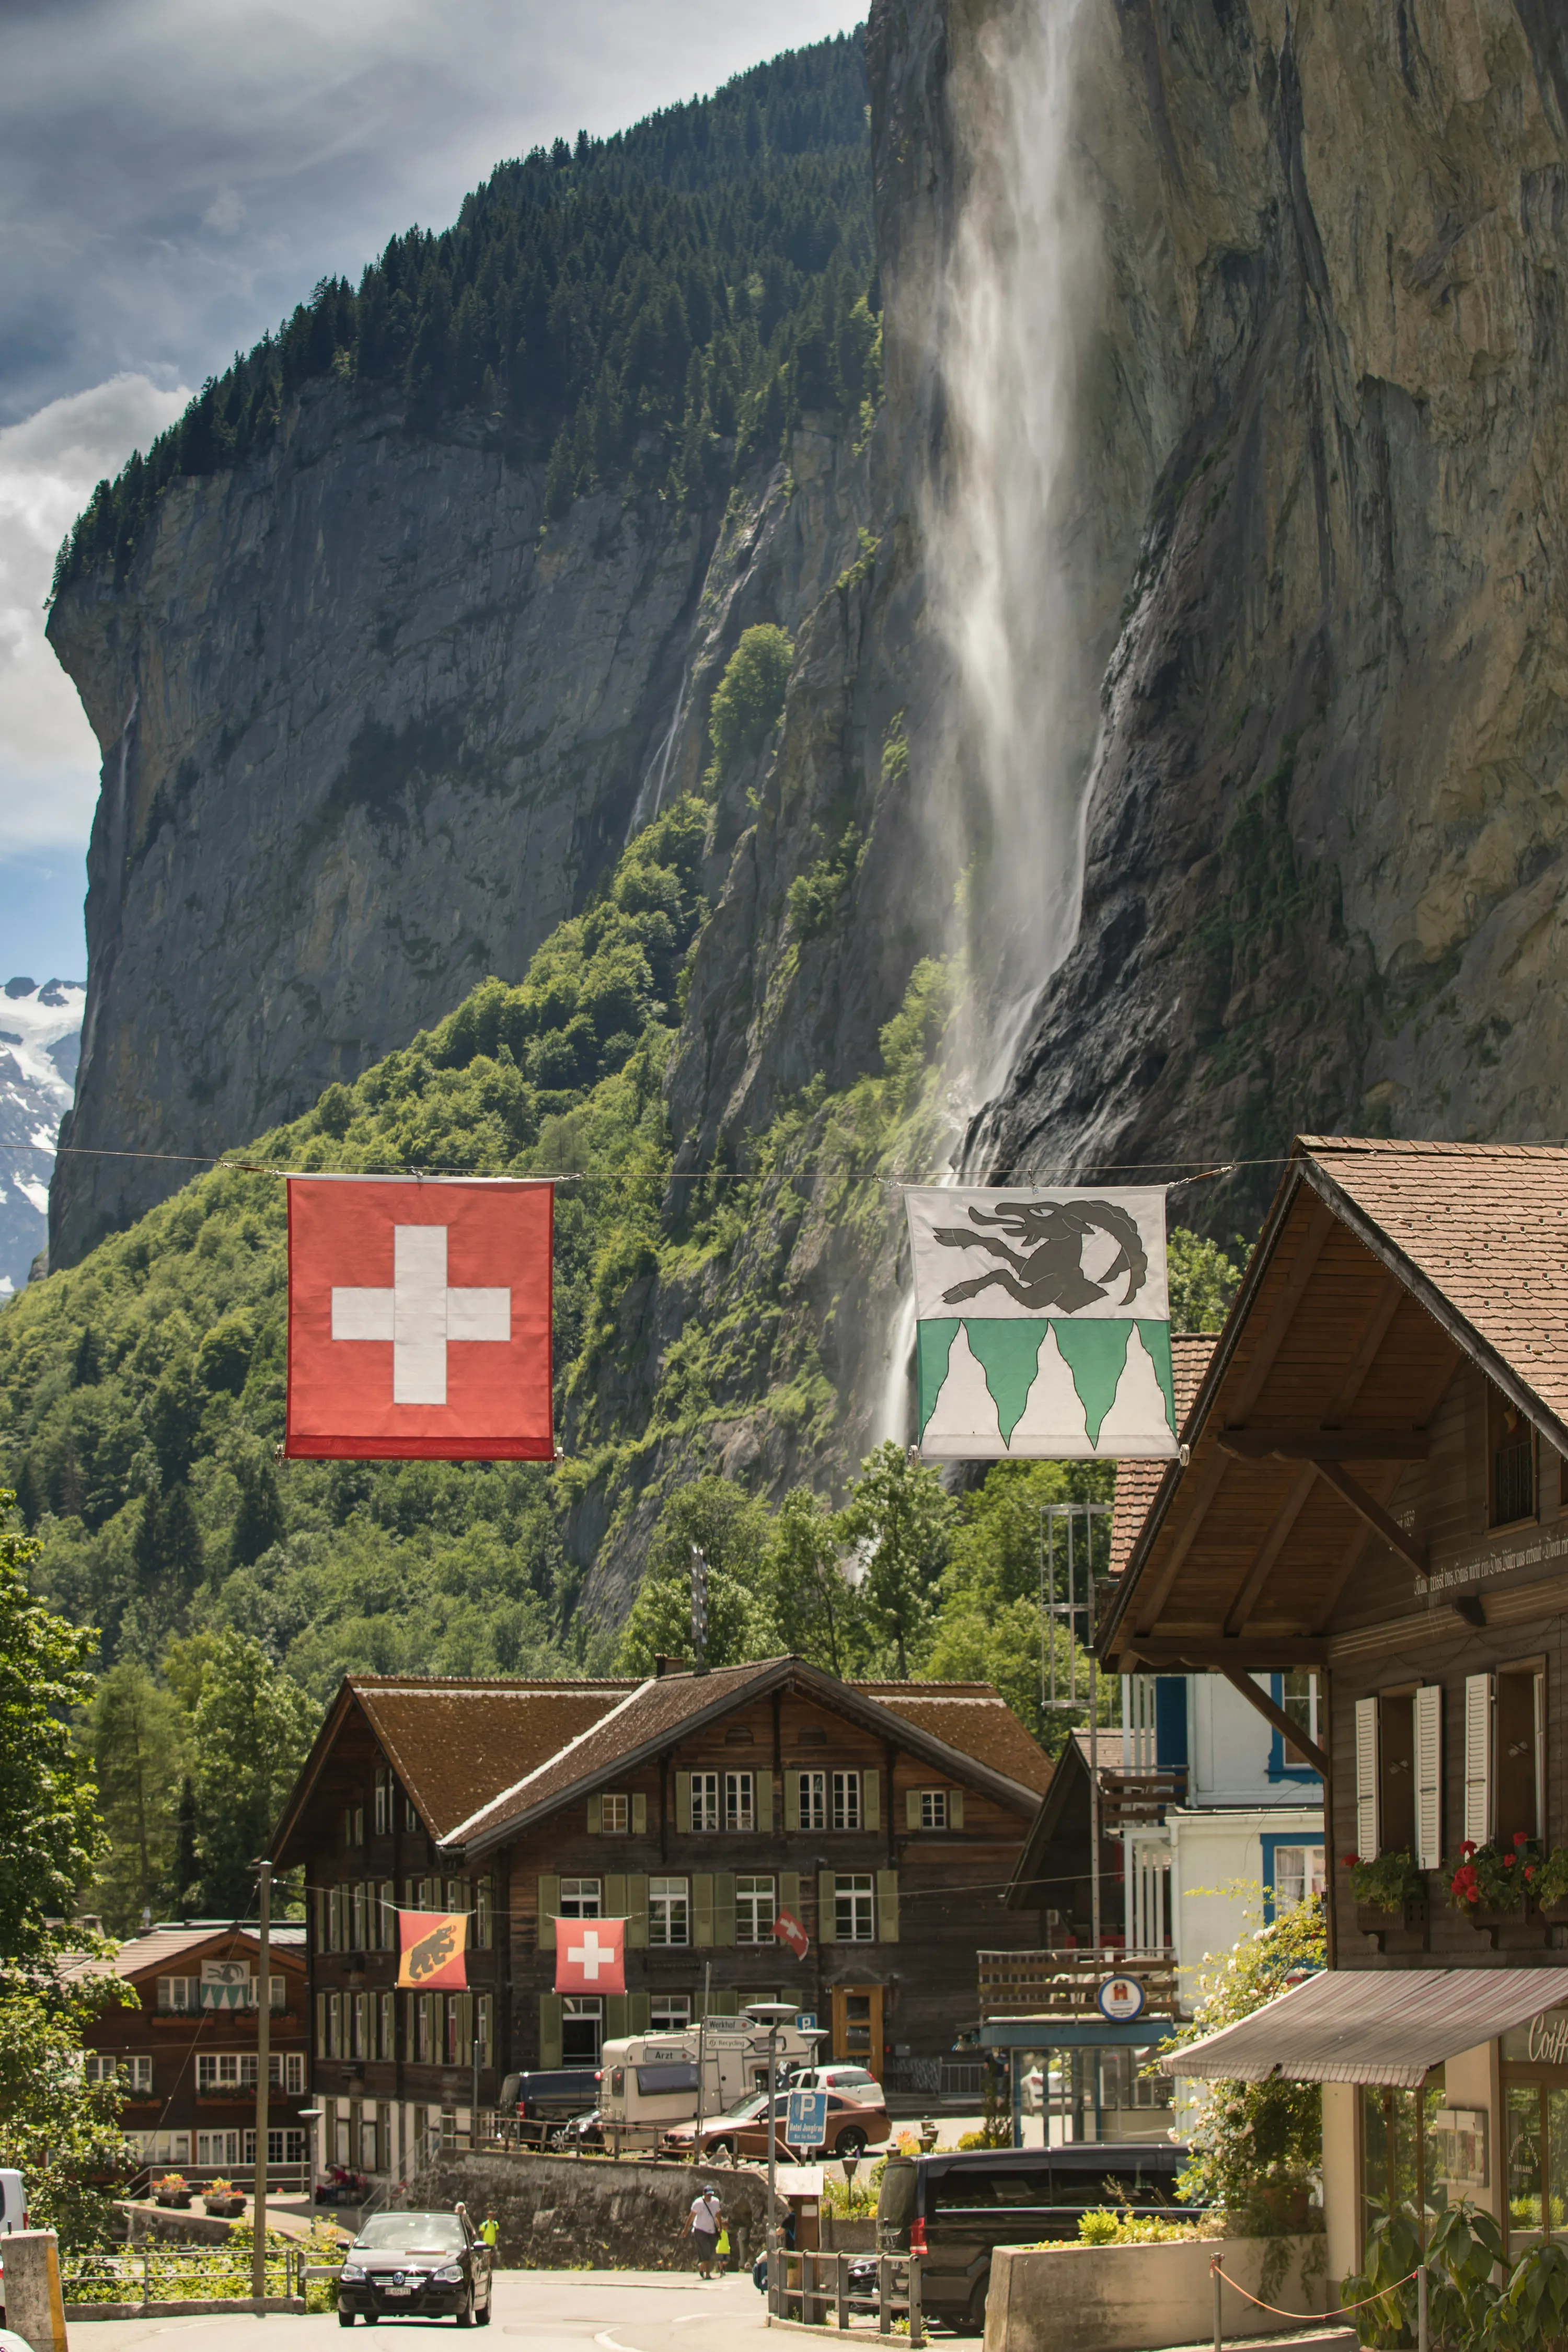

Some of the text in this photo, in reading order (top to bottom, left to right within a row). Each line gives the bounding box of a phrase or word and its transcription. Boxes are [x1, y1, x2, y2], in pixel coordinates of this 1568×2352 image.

[709, 2021, 736, 2029] Werkhof
[802, 2017, 811, 2030] P
[655, 2051, 673, 2060] Arzt
[800, 2095, 816, 2120] P
[1513, 2163, 1533, 2174] MARIANNE
